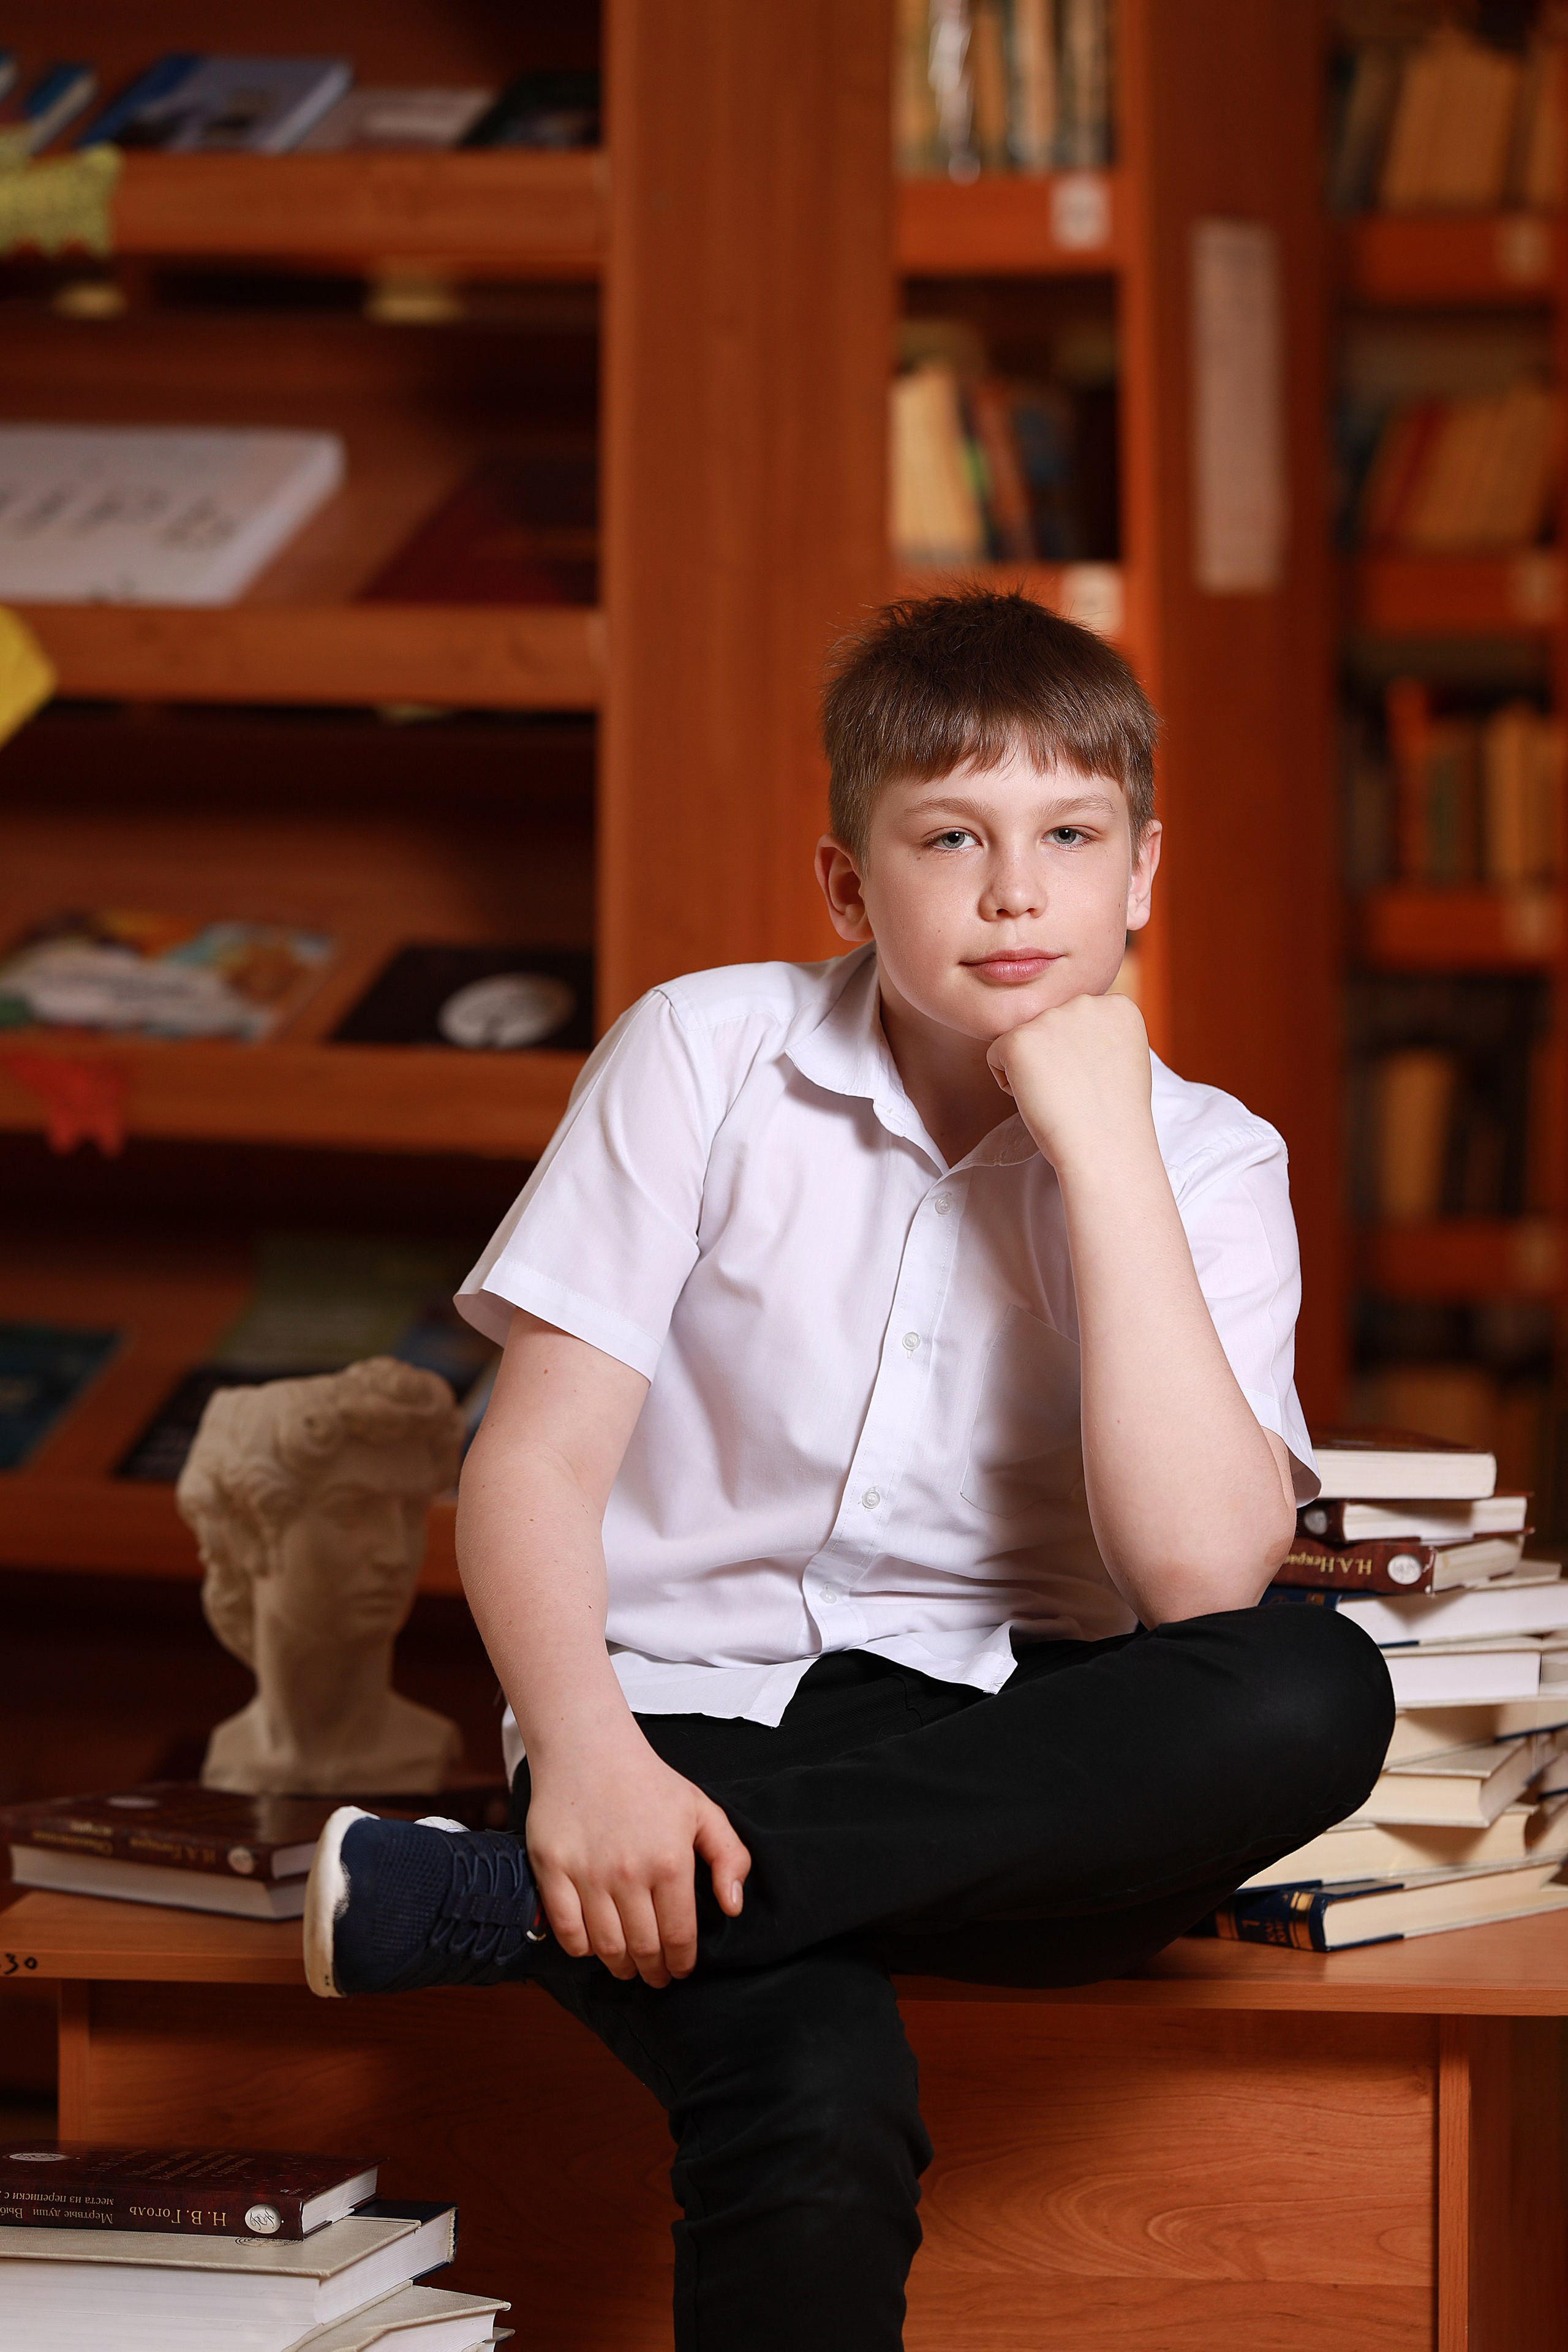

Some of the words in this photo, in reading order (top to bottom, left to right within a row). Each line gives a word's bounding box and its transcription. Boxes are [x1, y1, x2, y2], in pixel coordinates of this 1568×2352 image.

[12, 2192, 67, 2203] переписки
[69, 2195, 81, 2204] из
[85, 2196, 114, 2206] места
[32, 2207, 61, 2217] души
[64, 2210, 113, 2224] Мертвые
[129, 2206, 181, 2224] Гоголь
[186, 2210, 202, 2225] В.
[208, 2212, 227, 2226] Н.
